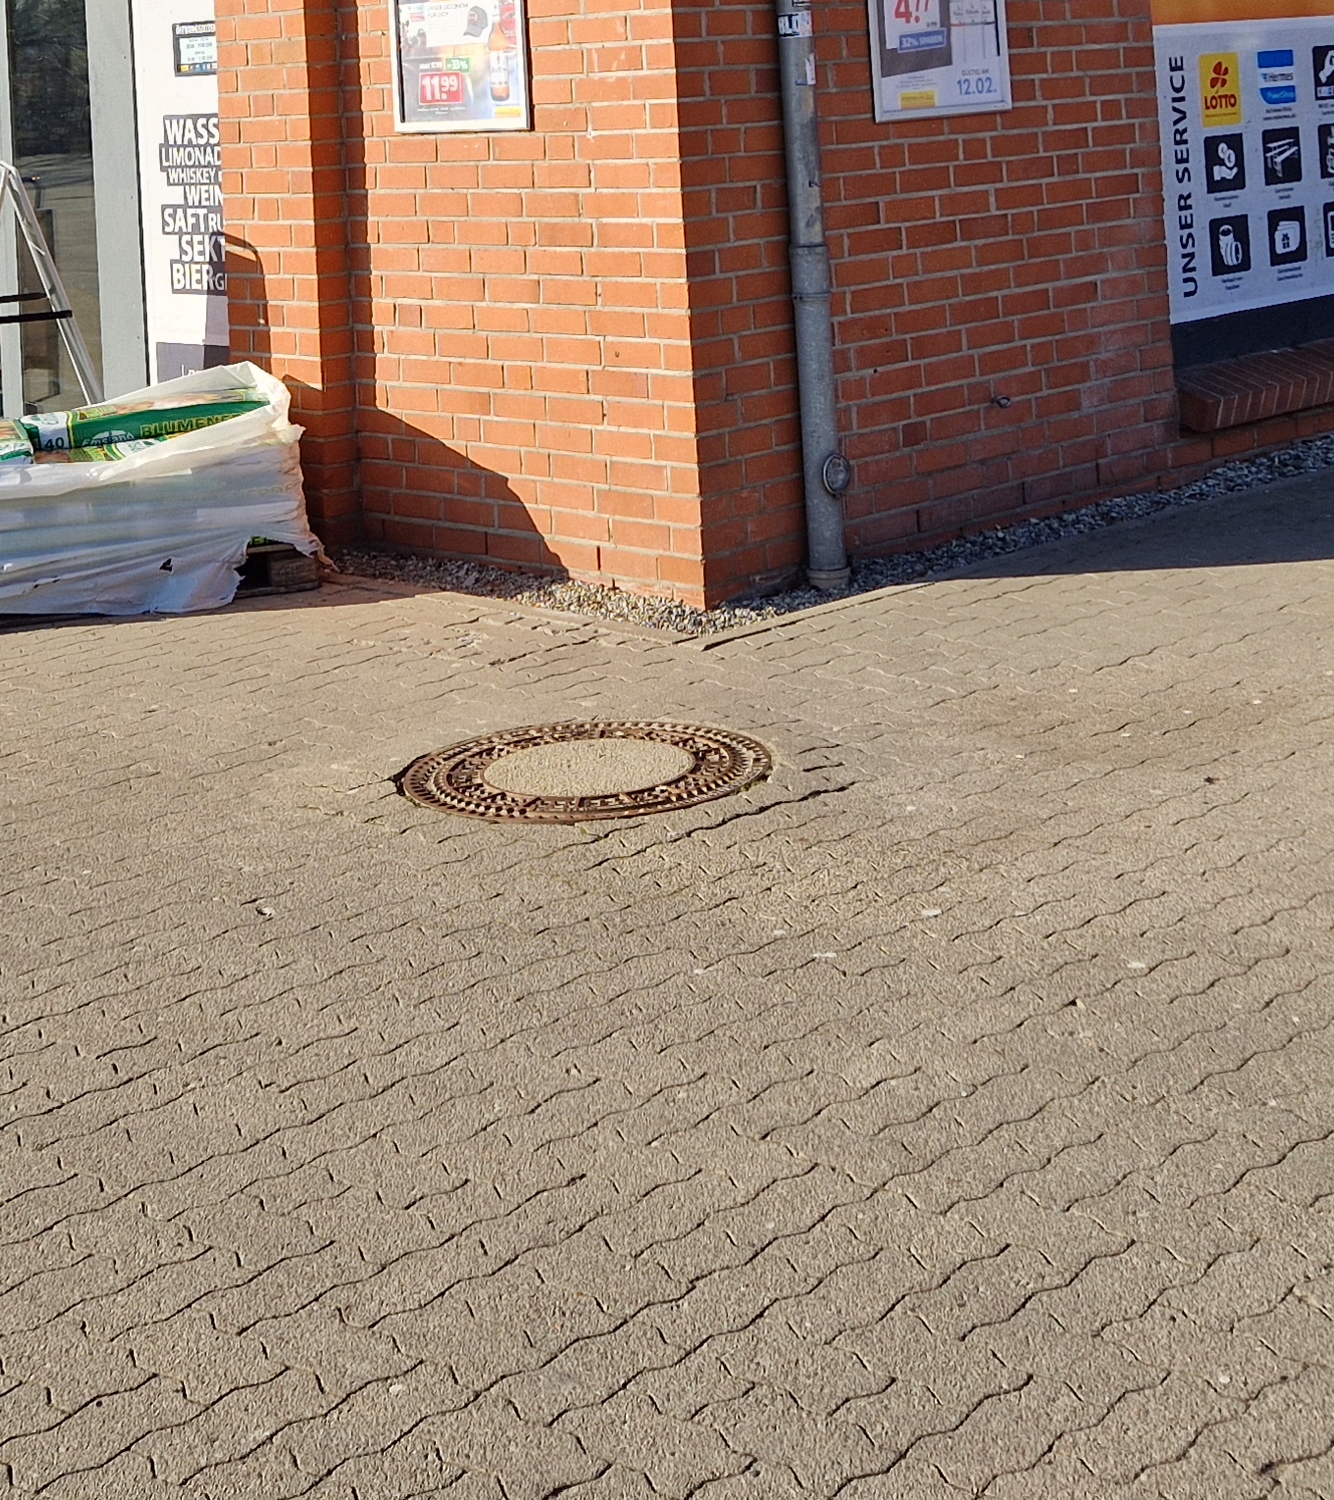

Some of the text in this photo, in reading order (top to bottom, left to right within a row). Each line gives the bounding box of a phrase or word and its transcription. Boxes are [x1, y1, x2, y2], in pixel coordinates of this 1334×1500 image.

[957, 77, 998, 96] 12.02.
[1204, 93, 1237, 110] LOTTO
[168, 168, 216, 183] WHISKEY
[1169, 56, 1198, 298] UNSER SERVICE
[163, 207, 207, 233] SAFT
[172, 263, 214, 290] BIER
[44, 437, 65, 450] 40
